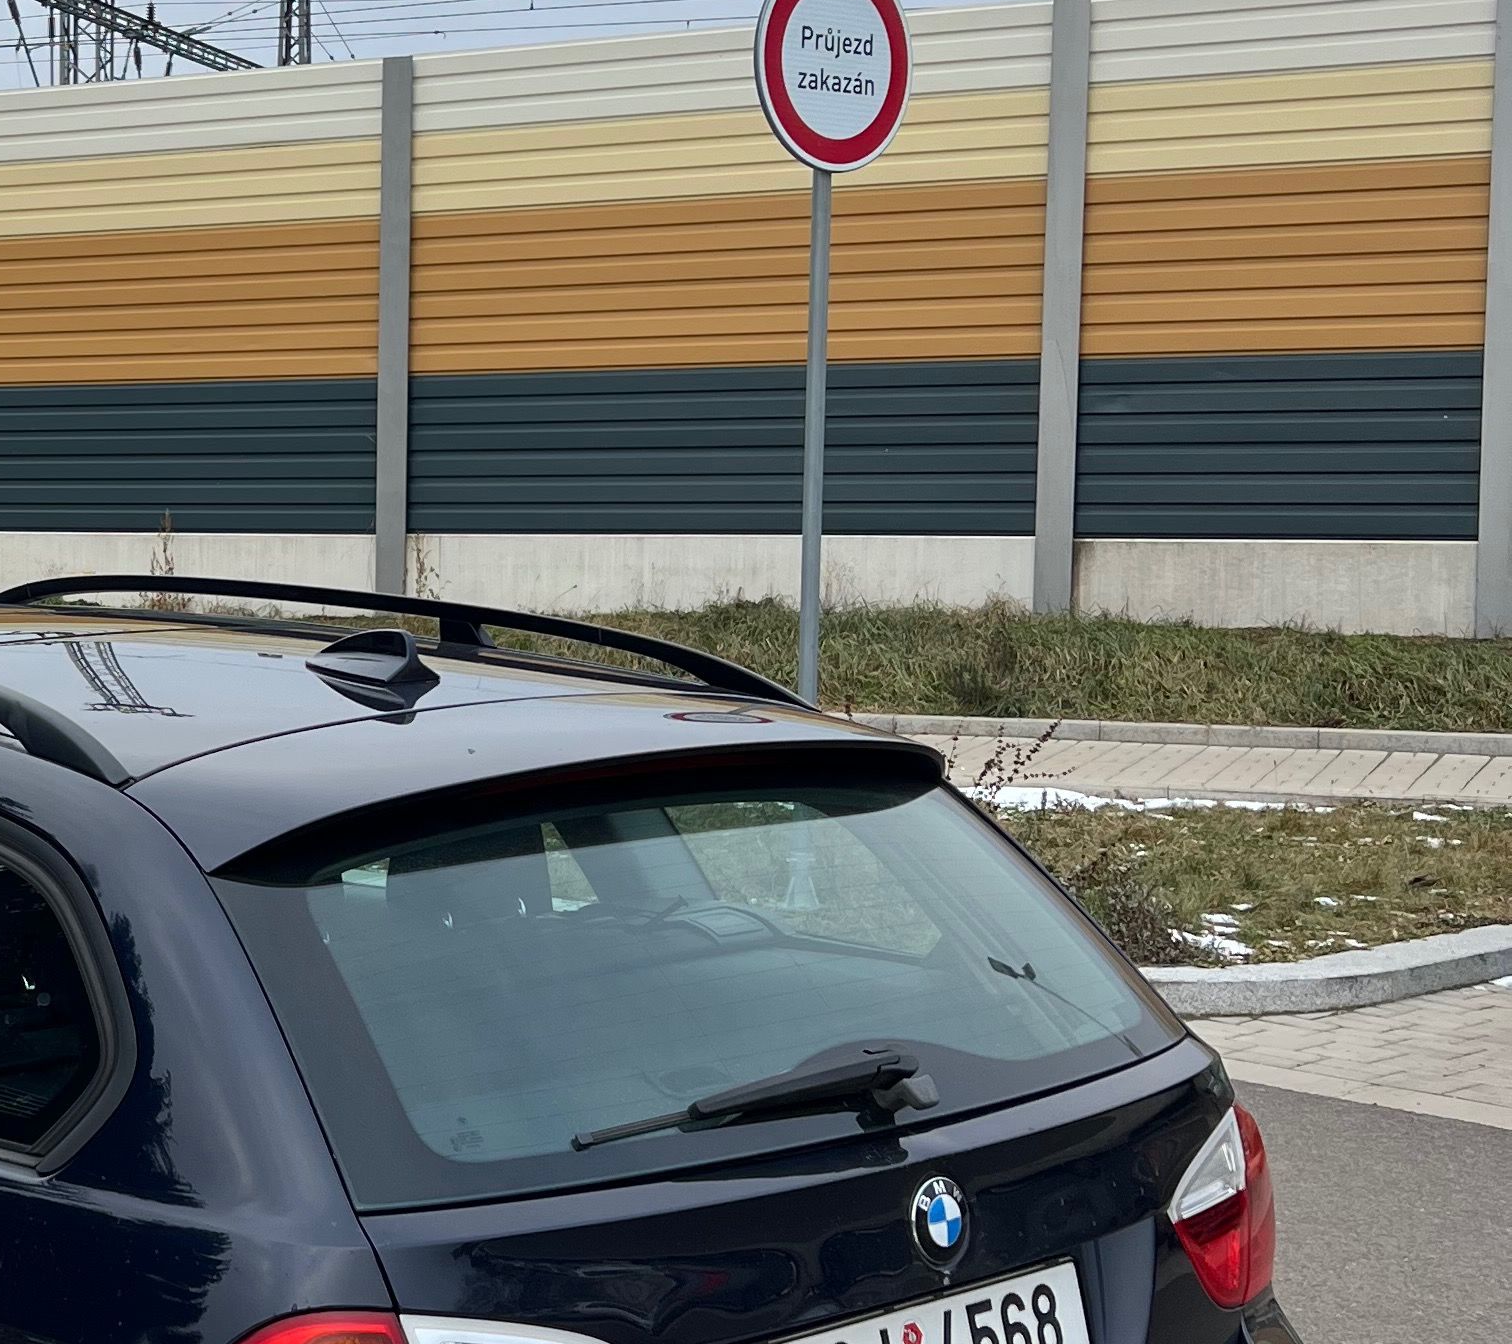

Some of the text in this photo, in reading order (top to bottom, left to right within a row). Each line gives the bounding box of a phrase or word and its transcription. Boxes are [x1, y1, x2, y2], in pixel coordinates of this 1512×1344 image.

[801, 25, 874, 58] Průjezd
[797, 68, 875, 96] zakazán
[918, 1179, 963, 1211] BMW
